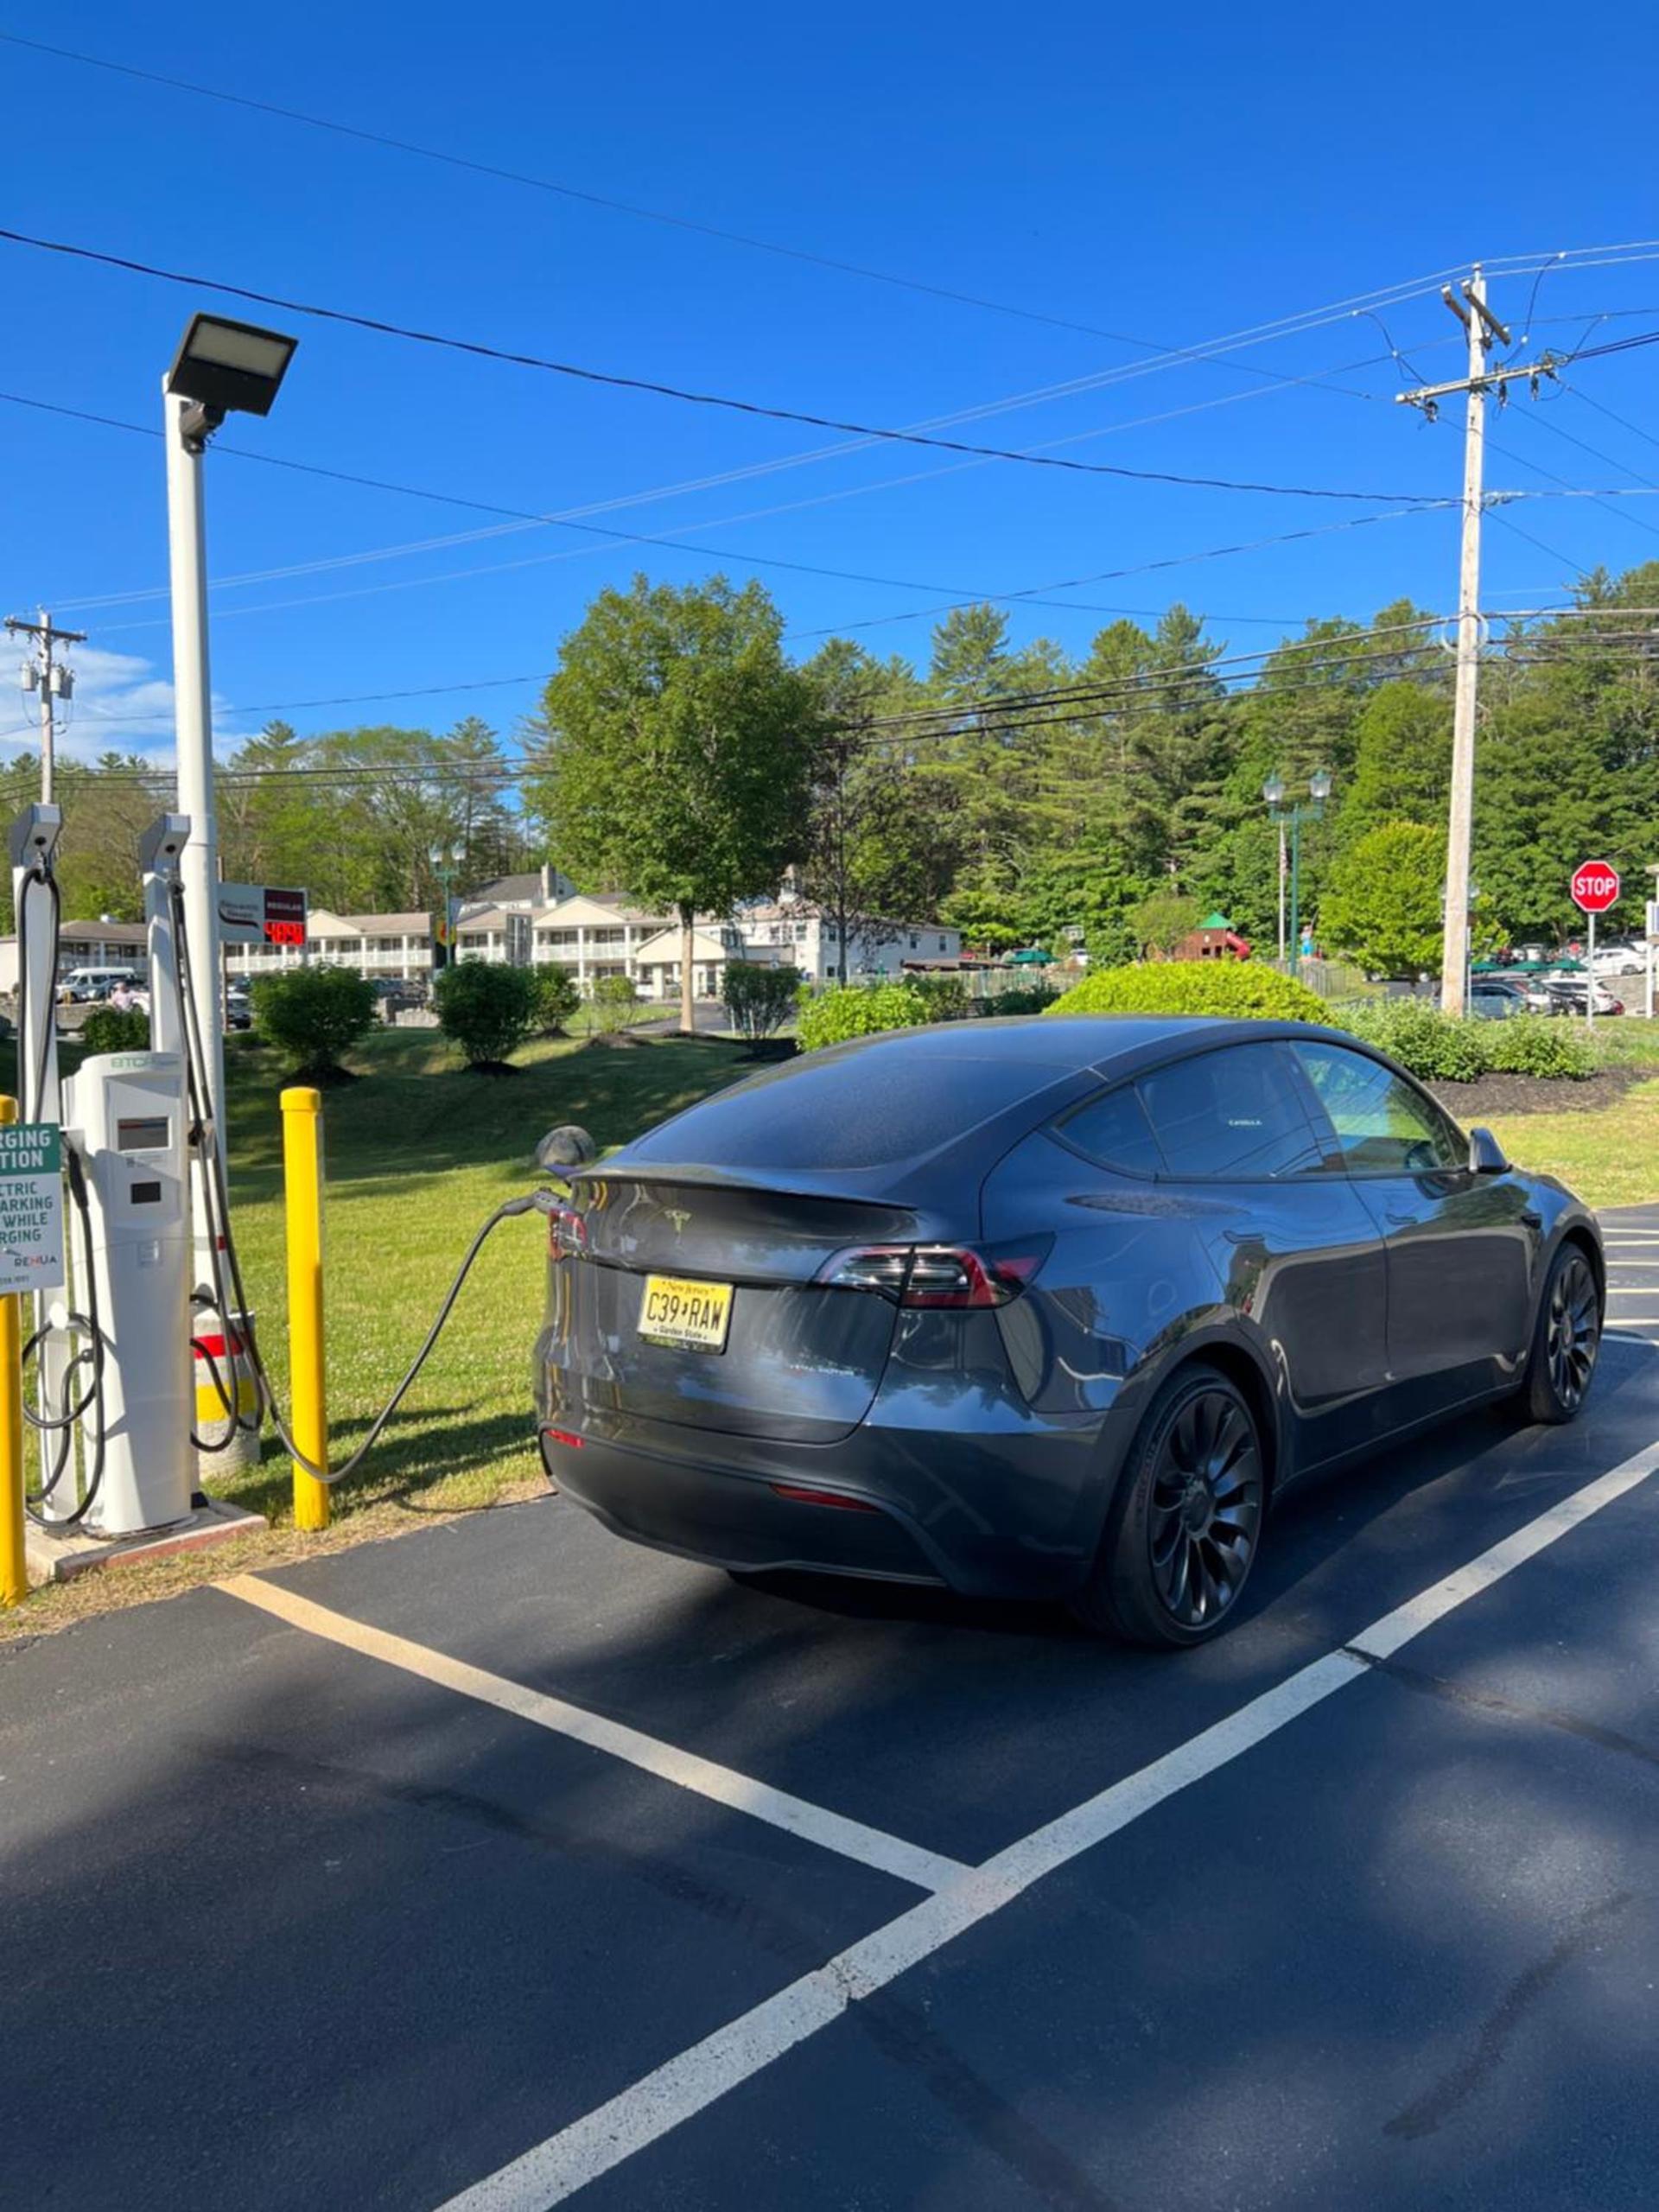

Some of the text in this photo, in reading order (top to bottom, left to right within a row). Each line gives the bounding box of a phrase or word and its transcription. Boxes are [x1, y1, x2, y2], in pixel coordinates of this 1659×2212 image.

[1575, 877, 1616, 896] STOP
[0, 1149, 43, 1169] TION
[3, 1212, 48, 1228] WHILE
[688, 1298, 724, 1331] RAW
